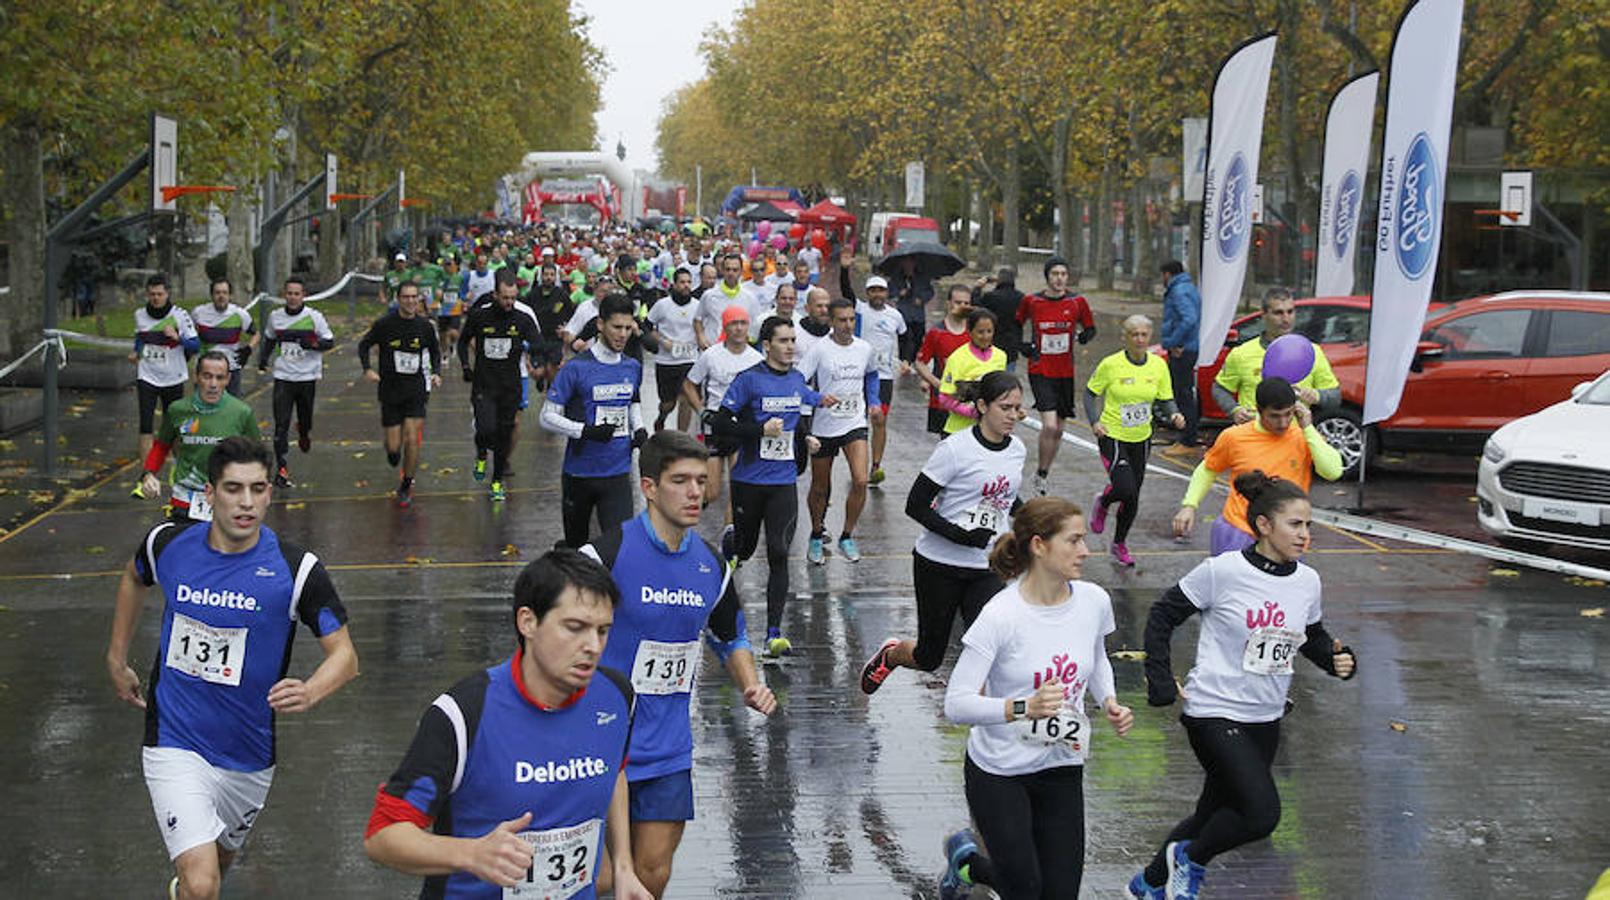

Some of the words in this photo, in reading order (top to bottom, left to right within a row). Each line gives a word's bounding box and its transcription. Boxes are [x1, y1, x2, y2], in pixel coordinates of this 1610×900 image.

[968, 513, 997, 529] 161
[177, 584, 261, 611] Deloitte.
[641, 586, 706, 607] Deloitte.
[1246, 601, 1286, 630] We
[180, 635, 230, 666] 131
[1256, 642, 1292, 661] 160
[644, 658, 687, 680] 130
[1030, 717, 1080, 741] 162
[515, 757, 608, 783] Deloitte.
[526, 845, 588, 882] 132
